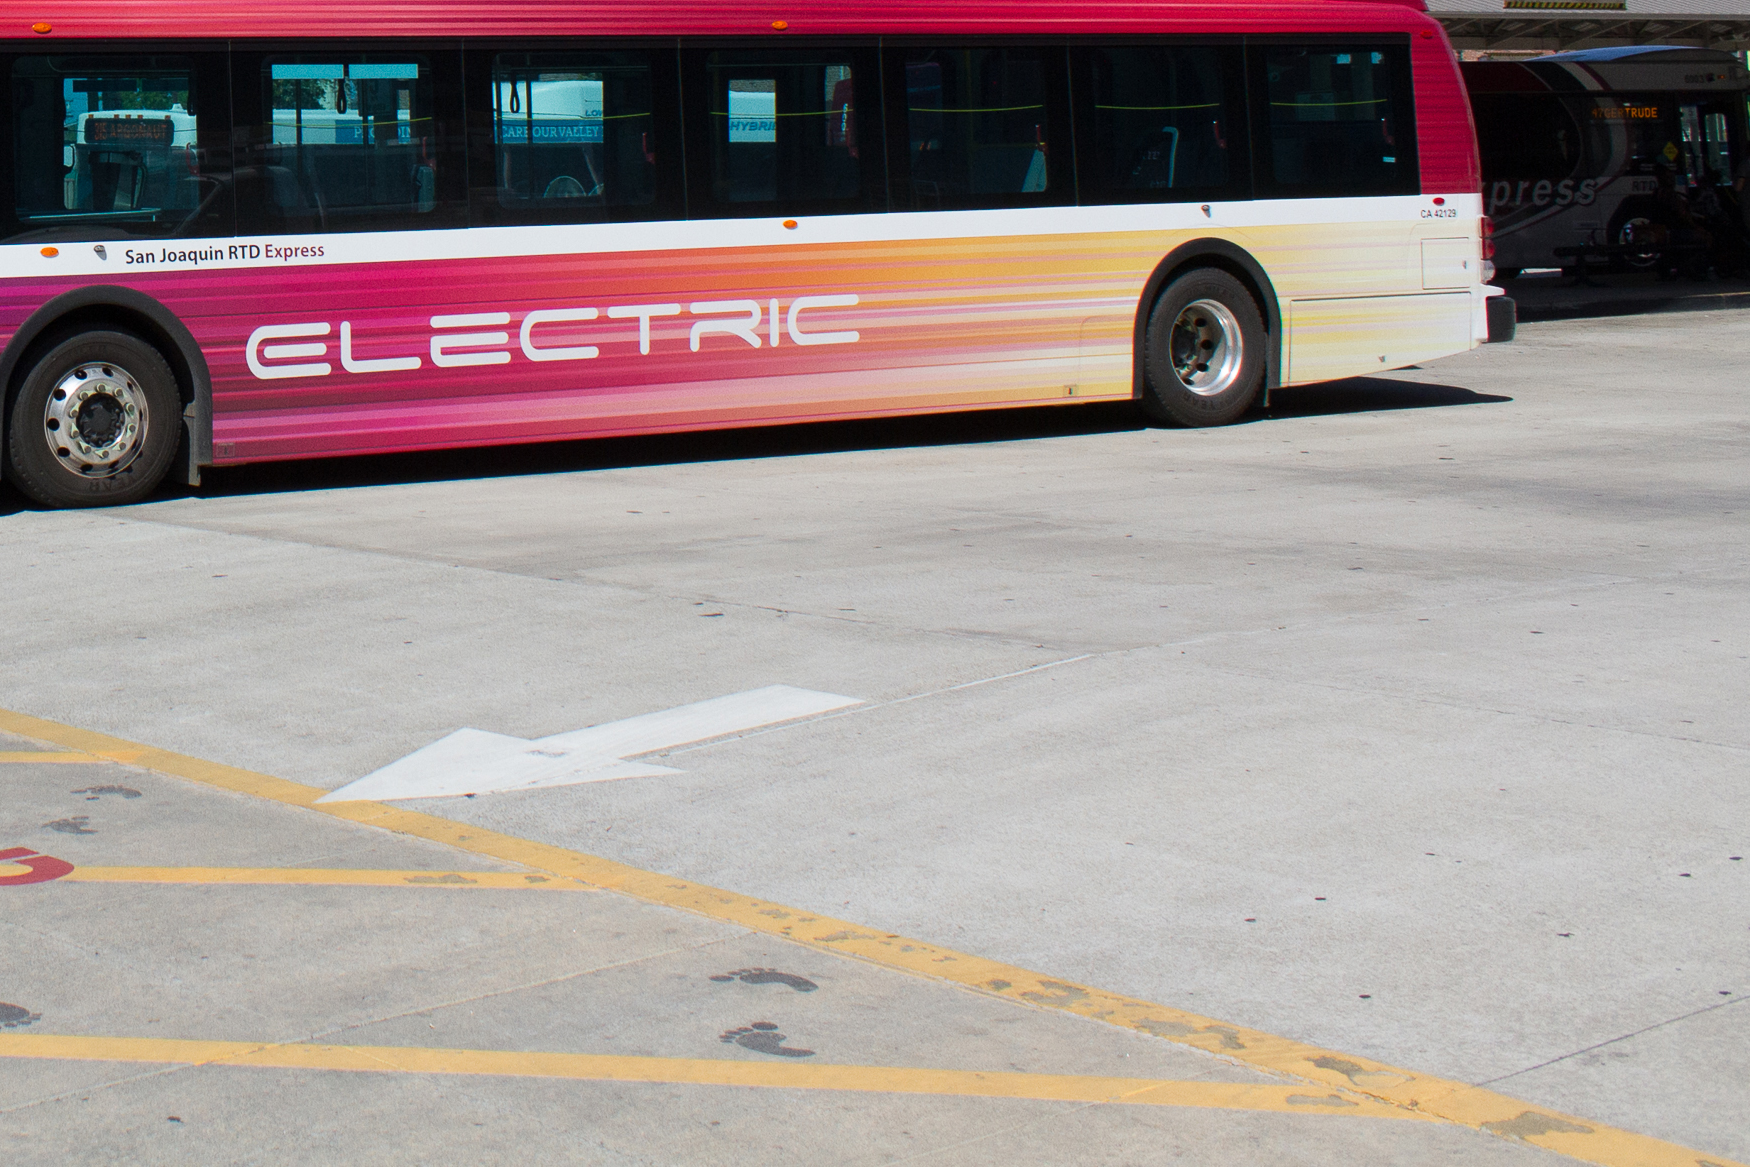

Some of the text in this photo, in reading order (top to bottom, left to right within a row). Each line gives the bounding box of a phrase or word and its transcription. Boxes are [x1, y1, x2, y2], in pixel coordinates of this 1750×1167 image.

[1603, 107, 1658, 118] GERTRUDE
[110, 124, 167, 139] ARGONAUT
[532, 127, 557, 137] OUR
[558, 127, 599, 137] VALLEY
[1631, 181, 1656, 192] RTD
[1483, 178, 1597, 214] press
[1420, 208, 1457, 219] CA 42129
[125, 244, 325, 265] San Joaquin RTD Express
[246, 294, 860, 380] ELECTRIC
